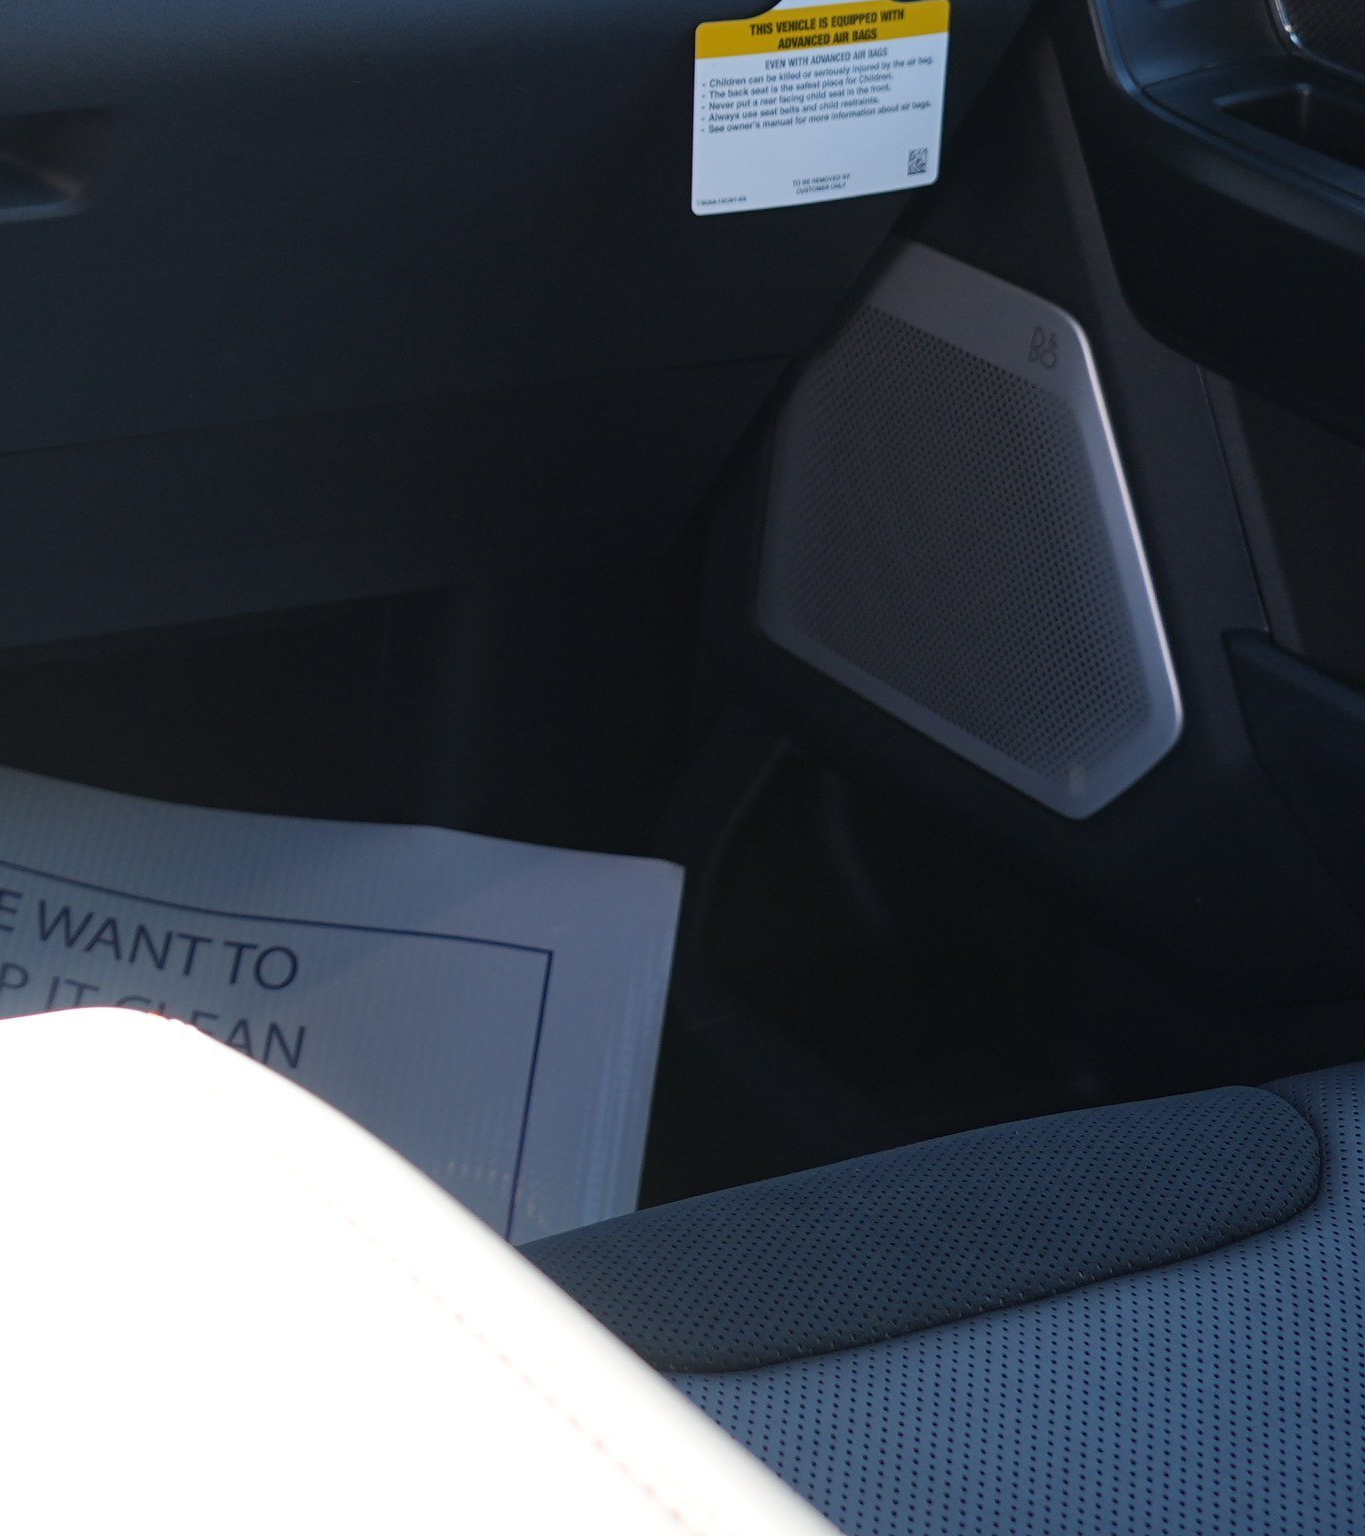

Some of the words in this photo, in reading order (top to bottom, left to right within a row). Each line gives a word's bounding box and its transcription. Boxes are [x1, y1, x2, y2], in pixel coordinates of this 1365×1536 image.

[750, 23, 772, 36] THIS
[776, 18, 815, 33] VEHICLE
[819, 17, 828, 28] IS
[831, 12, 877, 27] EQUIPPED
[880, 9, 904, 22] WITH
[778, 34, 830, 49] ADVANCED
[833, 32, 849, 43] AIR
[852, 29, 877, 41] BAGS
[765, 58, 785, 69] EVEN
[788, 56, 809, 66] WITH
[810, 51, 850, 64] ADVANCED
[853, 50, 865, 60] AIR
[868, 47, 887, 58] BAGS
[709, 76, 745, 87] Children
[749, 75, 763, 83] can
[766, 72, 776, 81] be
[779, 70, 800, 79] killed
[814, 65, 849, 76] seriously
[853, 61, 879, 72] injured
[882, 60, 890, 69] by
[892, 59, 904, 67] the
[906, 57, 915, 66] air
[709, 91, 725, 99] The
[728, 89, 748, 97] back
[751, 86, 768, 95] seat
[771, 85, 777, 93] is
[781, 84, 793, 92] the
[796, 81, 819, 90] safest
[822, 78, 843, 88] place
[846, 77, 856, 85] for
[709, 101, 733, 111] Never
[737, 99, 750, 108] put
[779, 93, 804, 104] facing
[806, 91, 826, 100] child
[829, 89, 844, 98] seat
[847, 88, 854, 96] in
[857, 87, 868, 95] the
[709, 111, 739, 123] Always
[760, 107, 777, 117] seat
[780, 105, 799, 114] belts
[802, 103, 816, 112] and
[819, 101, 838, 110] child
[709, 124, 724, 133] See
[727, 121, 759, 131] owner's
[763, 116, 793, 127] manual
[795, 115, 806, 123] for
[809, 114, 829, 122] more
[831, 107, 875, 119] information
[878, 105, 898, 114] about
[901, 104, 909, 112] air
[39, 899, 213, 976] WANT
[223, 940, 298, 990] TO
